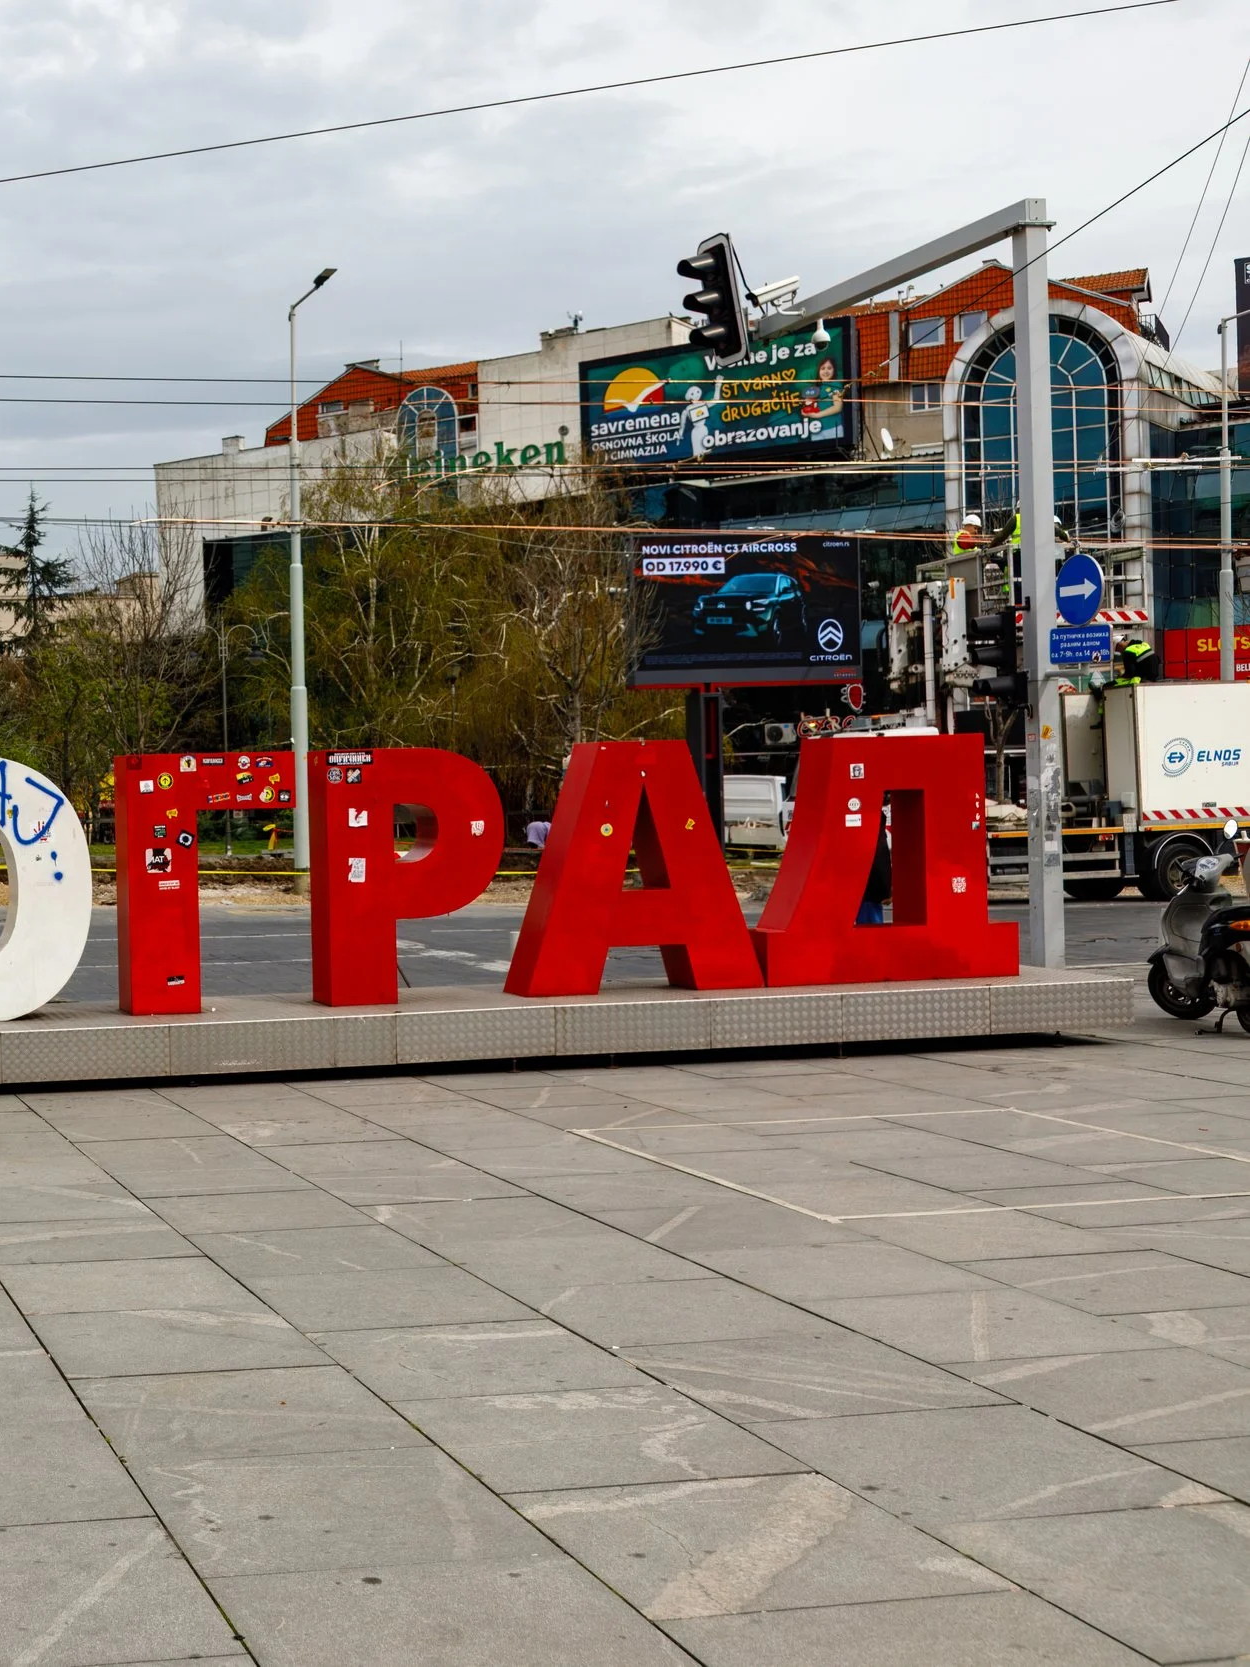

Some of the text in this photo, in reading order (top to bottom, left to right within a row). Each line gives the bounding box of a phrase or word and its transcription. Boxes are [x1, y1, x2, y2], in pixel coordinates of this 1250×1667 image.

[769, 343, 791, 366] je
[794, 341, 818, 357] za
[591, 411, 681, 437] savremena
[702, 417, 822, 448] obrazovanje
[591, 430, 681, 453] OSNOVNA ŠKOLA
[611, 444, 668, 462] GIMNAZIJA
[641, 542, 797, 555] NOVI CITROËN C3 AIRCROSS
[645, 560, 722, 573] OD 17.990 €
[1197, 636, 1250, 652] SLTS
[1196, 749, 1242, 762] ELNOS
